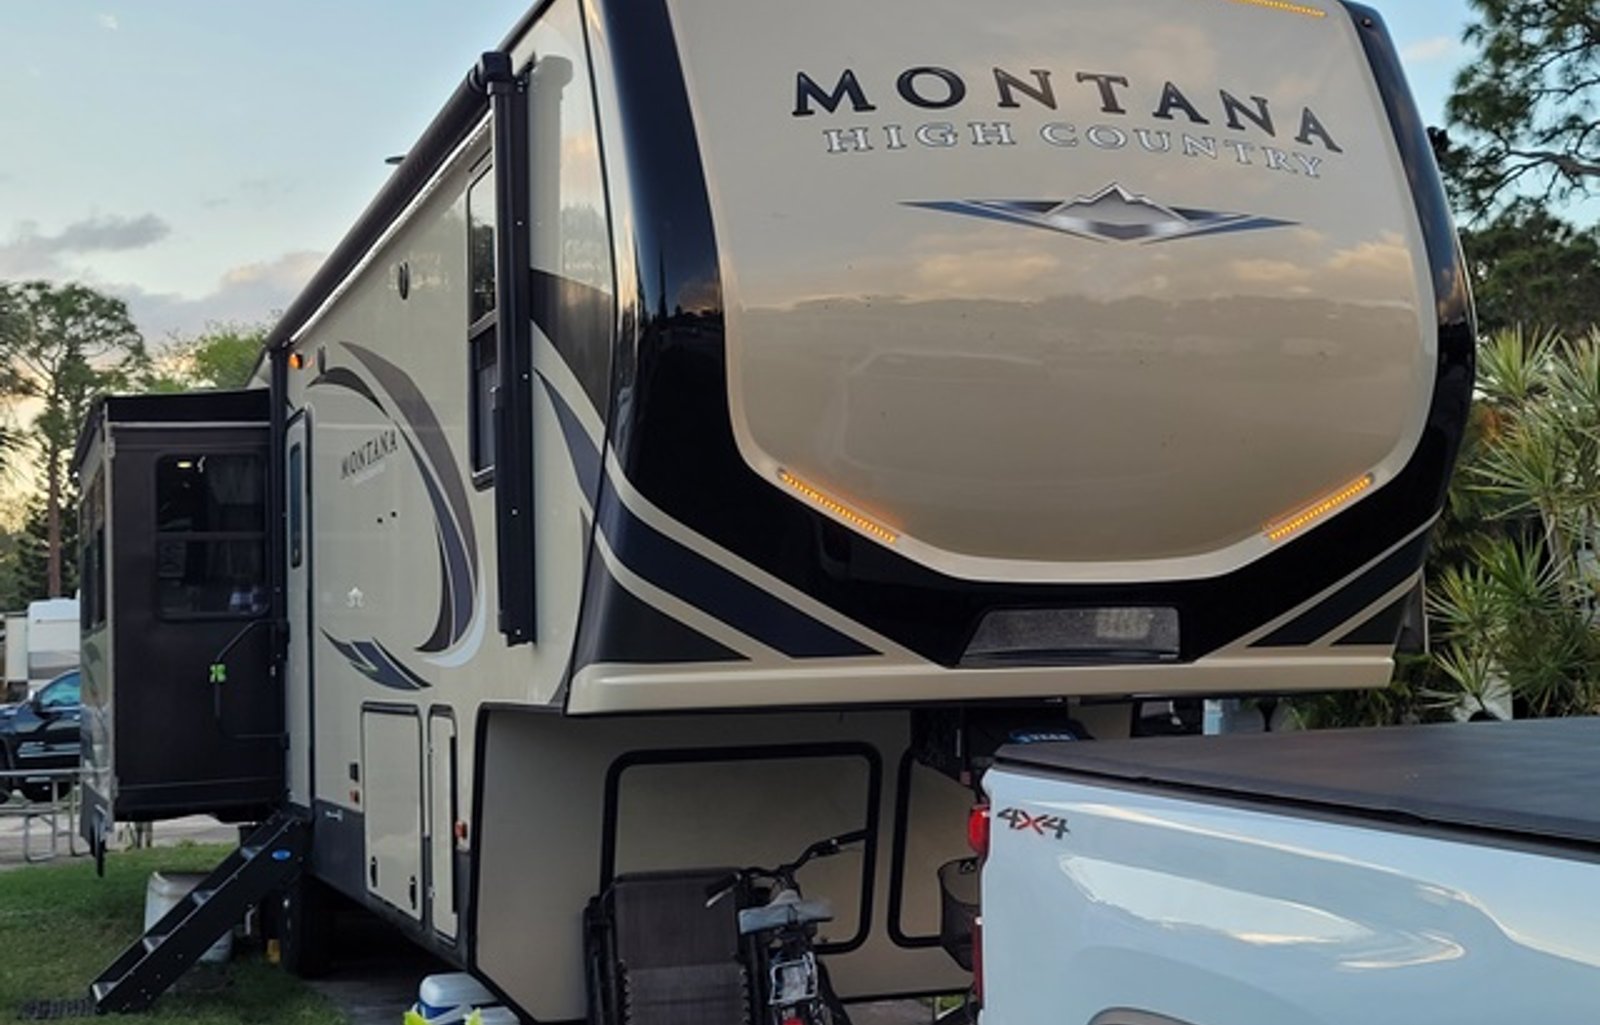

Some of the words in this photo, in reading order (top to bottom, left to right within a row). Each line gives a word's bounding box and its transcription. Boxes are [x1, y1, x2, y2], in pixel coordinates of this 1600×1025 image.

[792, 66, 1344, 153] MONTANA
[823, 121, 1017, 153] HIGH
[1040, 124, 1325, 179] COUNTRY
[340, 429, 399, 480] MONTANA
